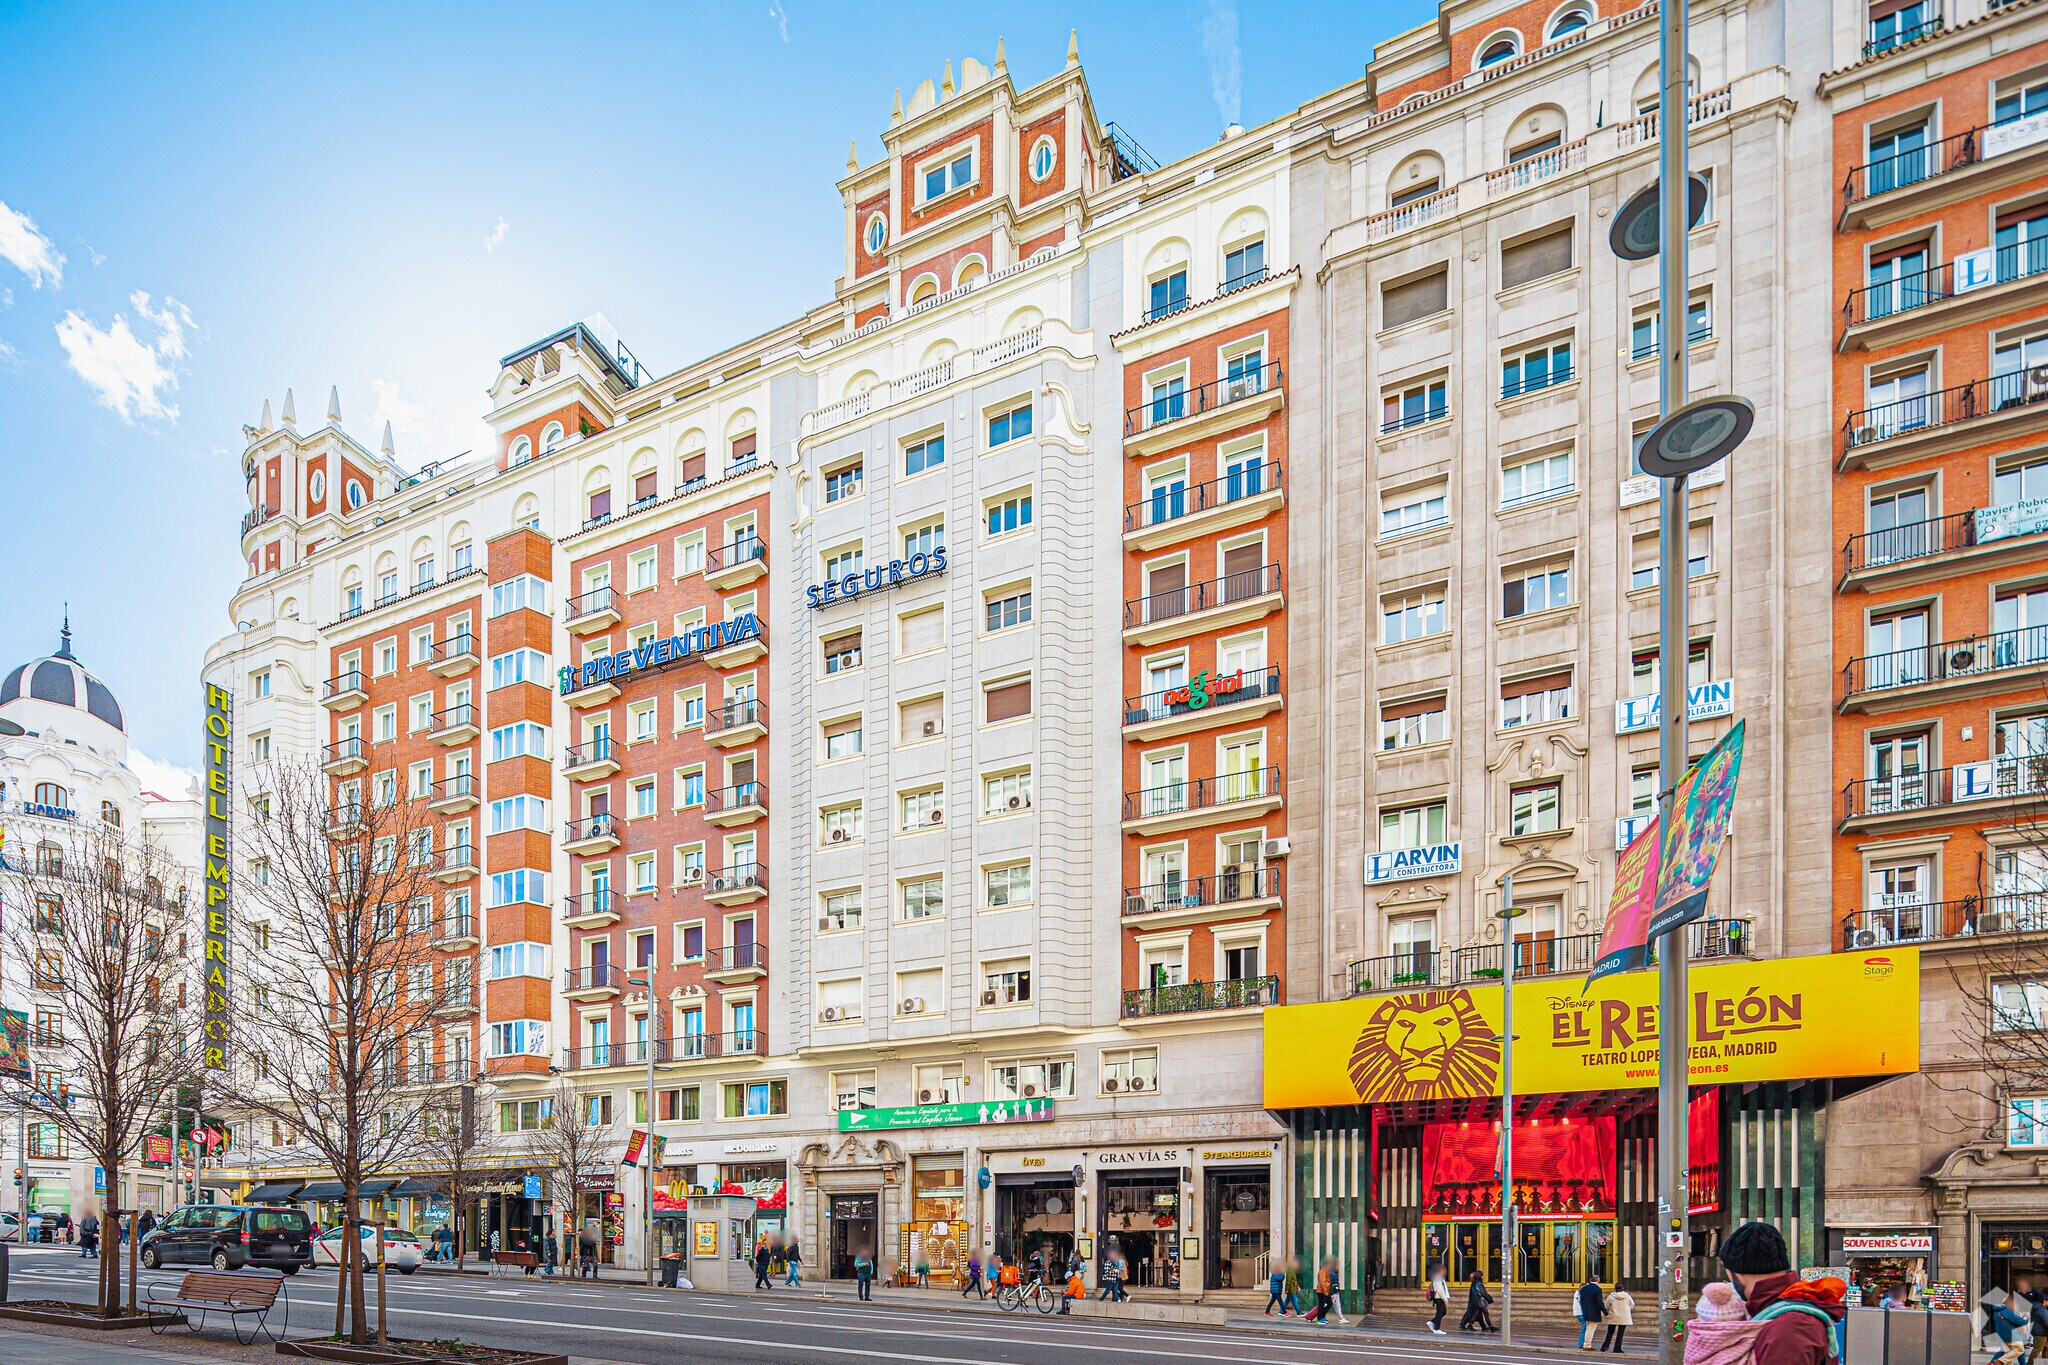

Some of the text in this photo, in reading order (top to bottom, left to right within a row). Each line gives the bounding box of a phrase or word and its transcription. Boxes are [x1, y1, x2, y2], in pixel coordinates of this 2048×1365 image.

[1978, 505, 2014, 518] Javier
[806, 545, 947, 608] SEGUROS
[582, 612, 760, 685] PREVENTIVA
[1164, 668, 1243, 709] negrini
[1623, 682, 1730, 729] LAVIN
[1656, 703, 1724, 722] IILIARIA
[206, 683, 229, 821] HOTEL
[1963, 768, 1990, 796] L
[1371, 844, 1459, 880] LARVIN
[1397, 863, 1455, 876] CONSTRUCTORA
[204, 833, 229, 1071] EMPERADOR
[1864, 967, 1893, 976] Stage
[1552, 986, 1802, 1049] EL RE LEÓN
[1582, 1051, 1628, 1067] TEATRO
[1725, 1041, 1777, 1057] MADRID
[1626, 1063, 1729, 1078] www.leon.es
[912, 1117, 921, 1125] del
[921, 1113, 943, 1126] Empleo
[944, 1113, 963, 1123] Joven
[938, 1108, 951, 1116] para
[723, 1143, 777, 1154] McDonald's
[1099, 1149, 1177, 1164] GRAN VÍA 55
[1202, 1150, 1272, 1160] STEAKBURGER
[584, 1177, 615, 1188] Jamón
[1843, 1238, 1930, 1248] SOUVENIRS G-VIA
